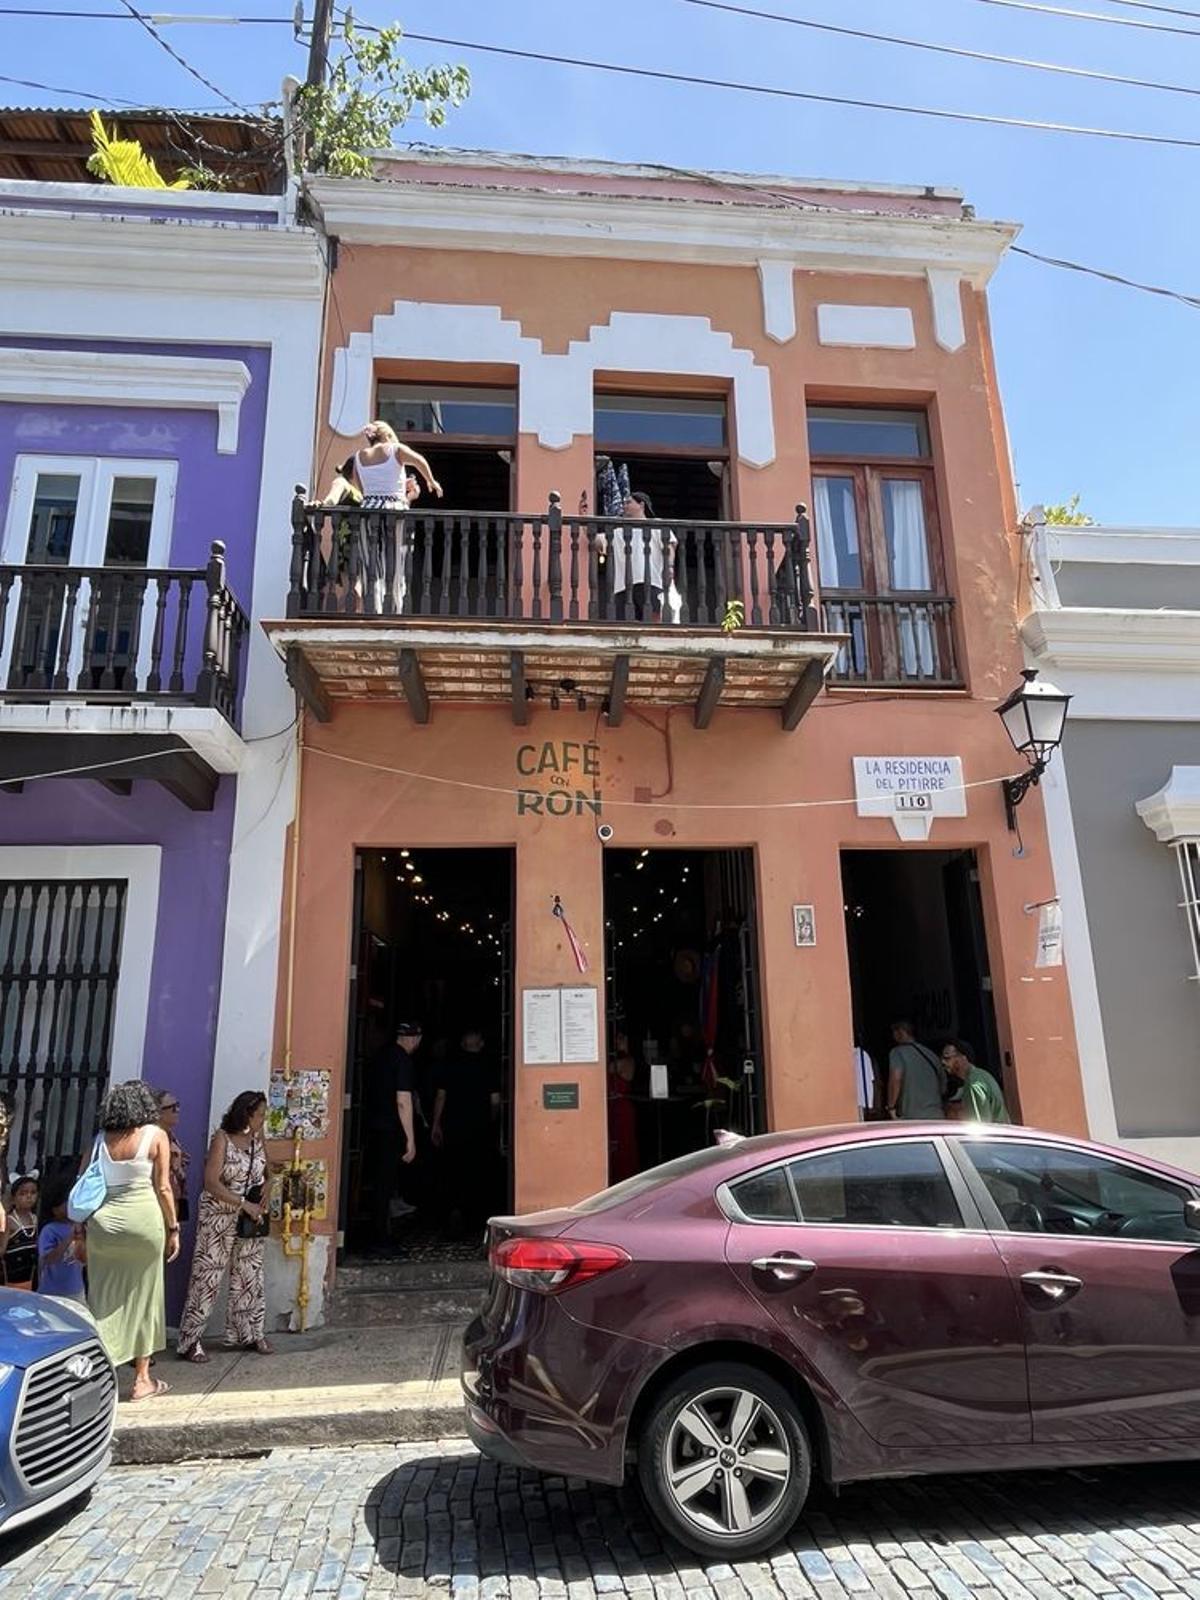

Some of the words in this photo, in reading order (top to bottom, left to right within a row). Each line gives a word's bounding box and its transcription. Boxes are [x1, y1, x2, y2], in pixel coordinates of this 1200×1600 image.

[516, 740, 601, 775] CAFÉ
[866, 761, 881, 775] LA
[885, 760, 951, 775] RESIDENCIA
[875, 778, 894, 790] DEL
[898, 777, 945, 790] PITIRRE
[517, 789, 602, 816] RON
[900, 796, 926, 807] 110
